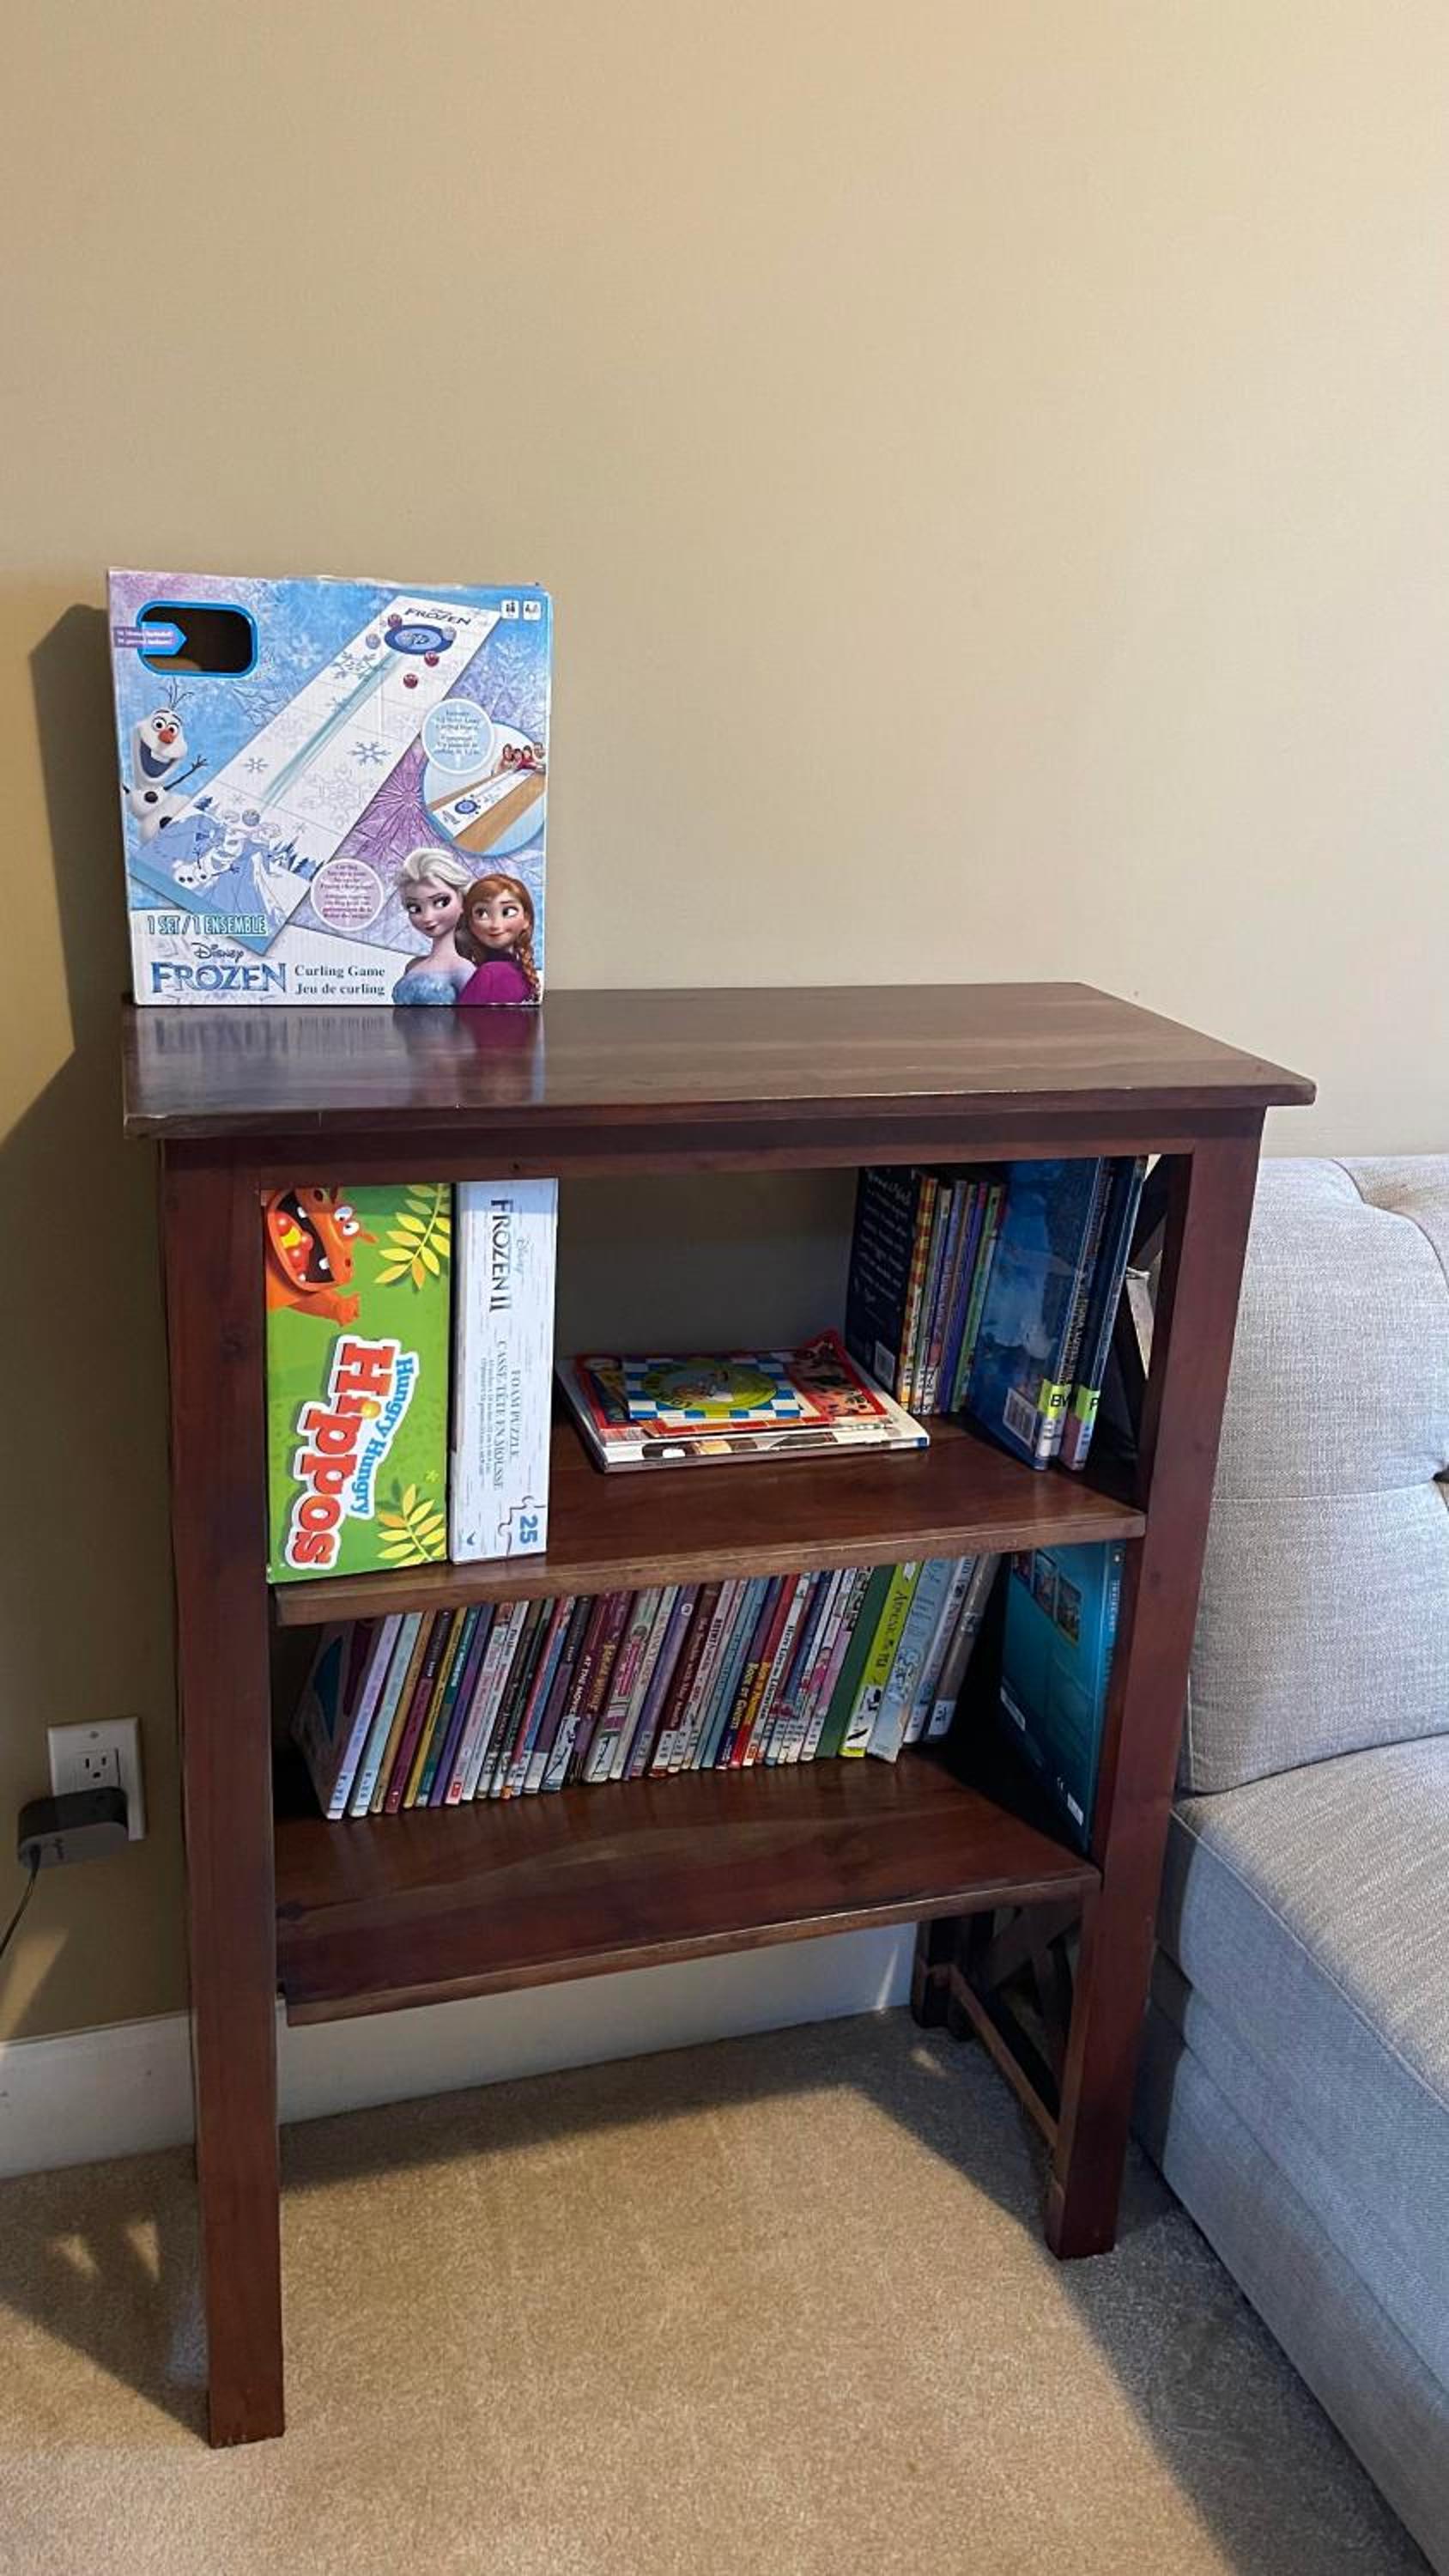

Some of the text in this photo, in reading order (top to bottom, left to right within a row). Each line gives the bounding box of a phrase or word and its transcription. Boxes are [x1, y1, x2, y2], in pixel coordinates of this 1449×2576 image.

[404, 607, 471, 626] FROZEN
[158, 915, 181, 935] SET
[203, 915, 266, 935] ENSEMBLE
[191, 942, 244, 963] Disney
[151, 962, 286, 993] FROZEN
[294, 965, 385, 979] Curling Game
[295, 984, 385, 997] Jeu de curling
[489, 1200, 513, 1312] FROZEN II
[510, 1370, 520, 1459] FOAM PUZZLE
[351, 1358, 414, 1514] Hungry Hungry
[495, 1420, 506, 1437] EN
[292, 1342, 396, 1564] Hippos
[494, 1437, 506, 1491] MOUSSE
[518, 1516, 538, 1544] 25
[783, 1625, 794, 1647] Here
[576, 1668, 588, 1686] THE
[743, 1661, 757, 1686] BOOK
